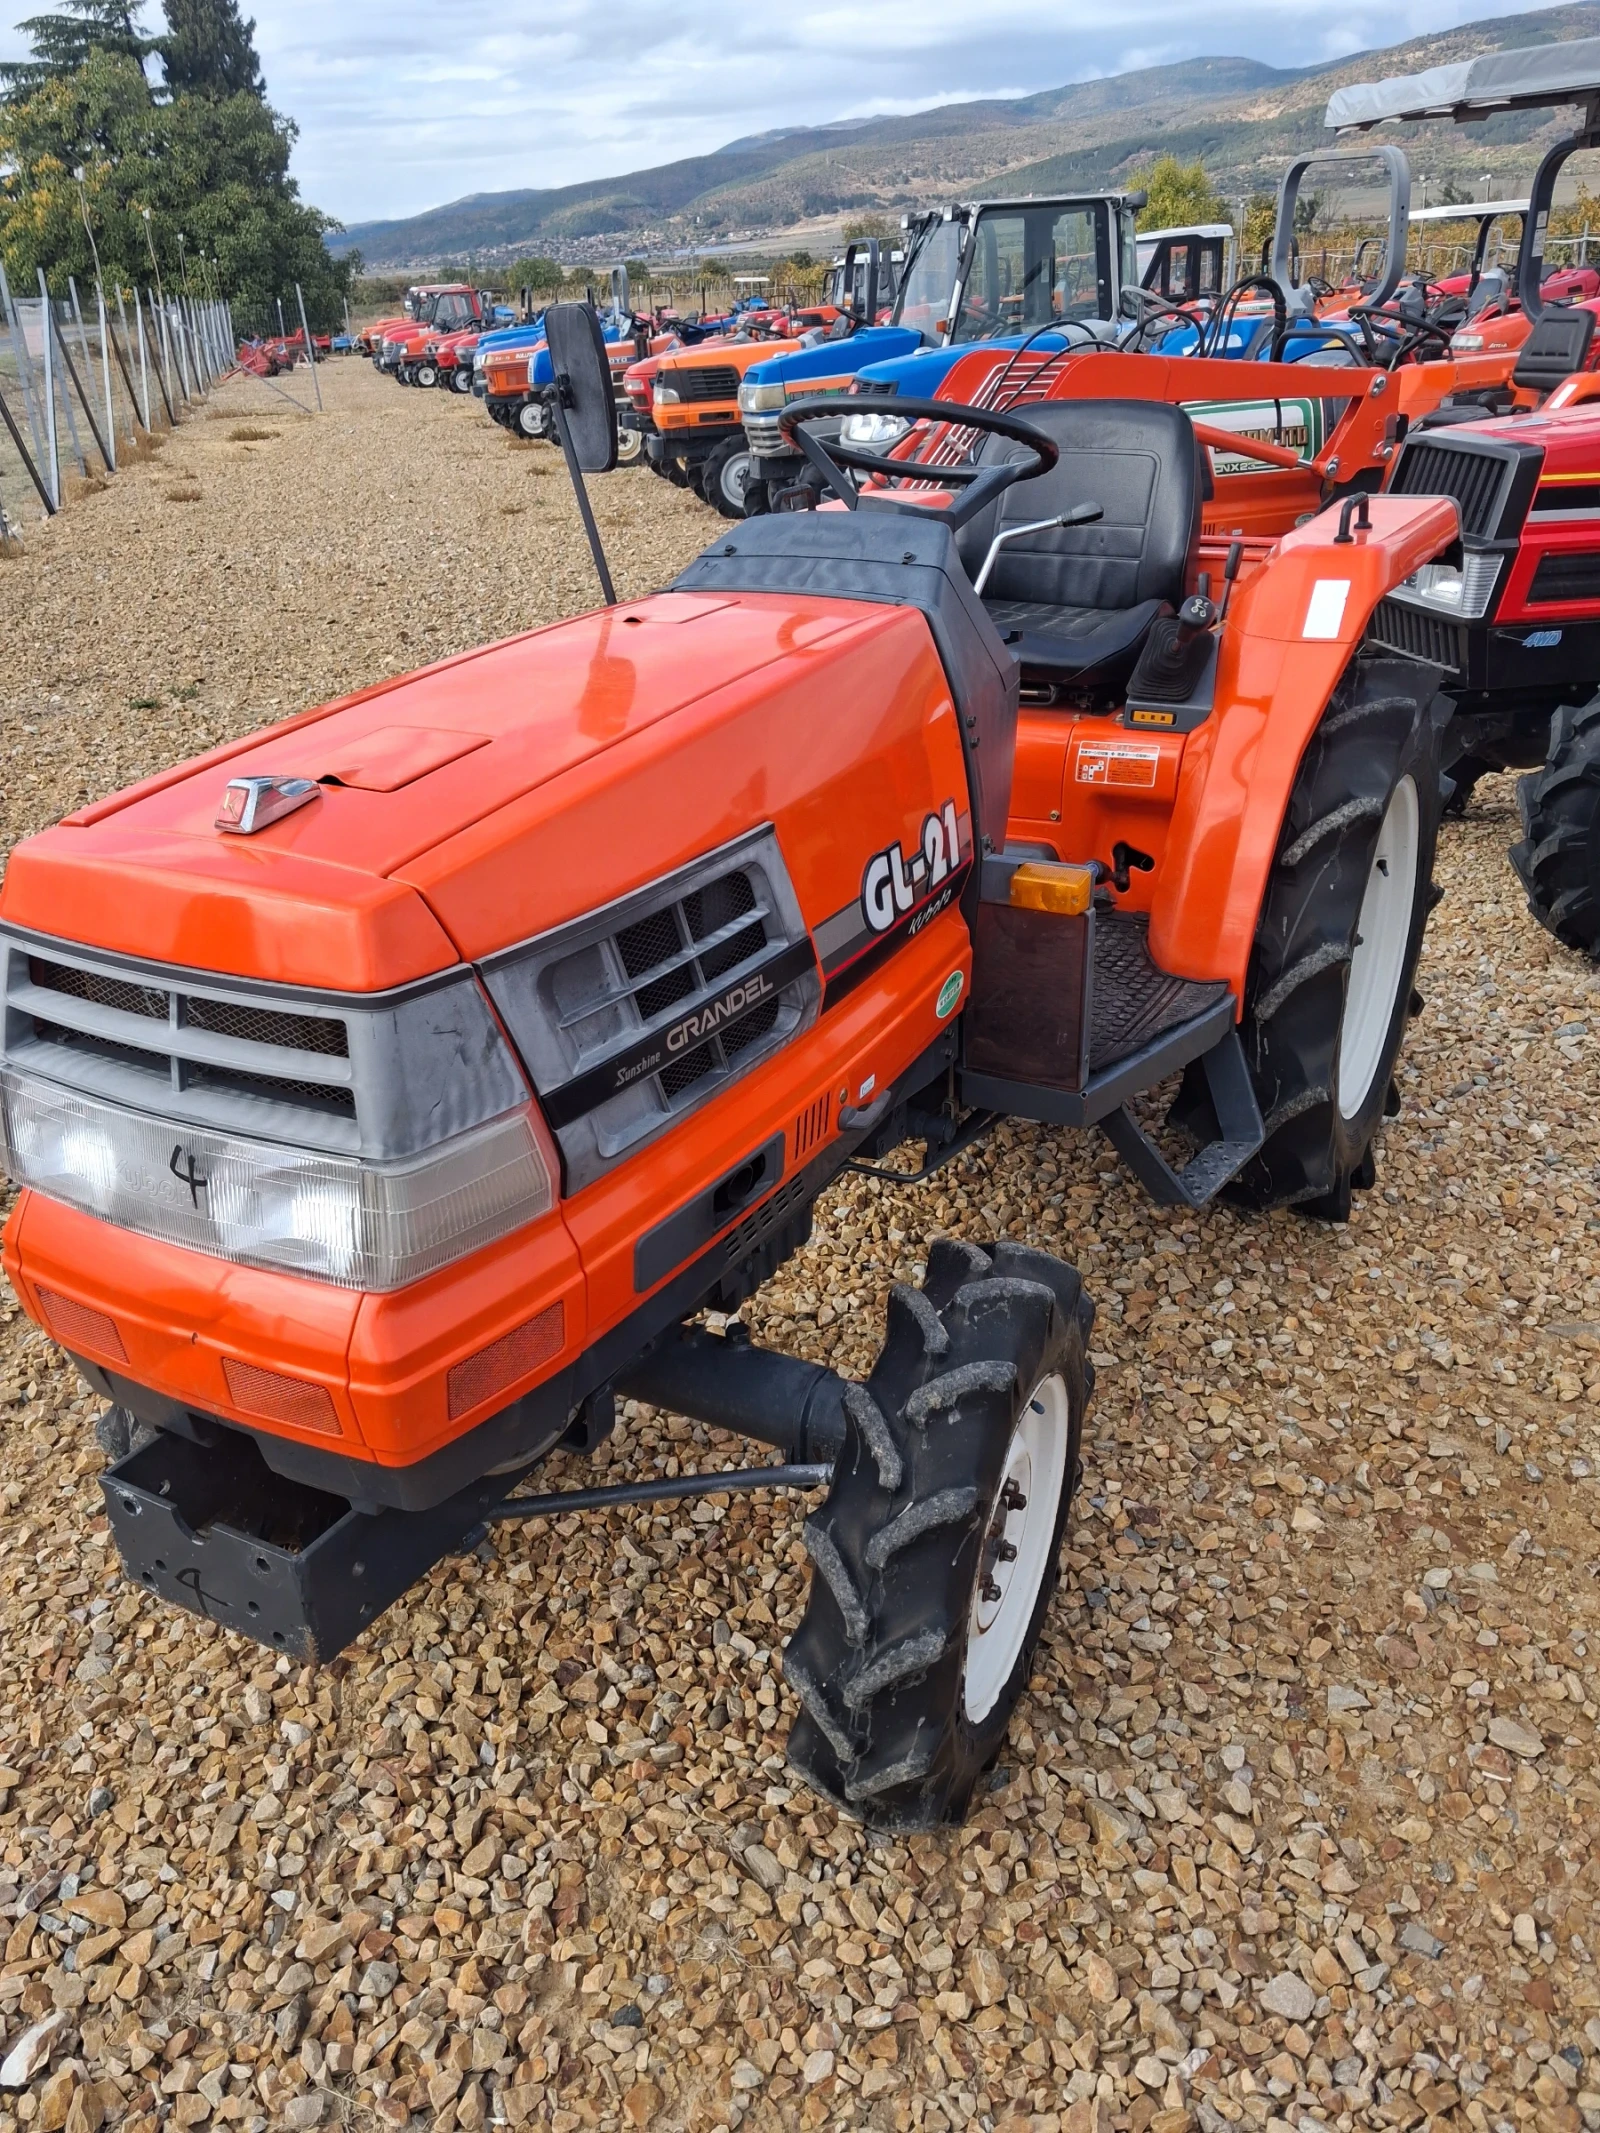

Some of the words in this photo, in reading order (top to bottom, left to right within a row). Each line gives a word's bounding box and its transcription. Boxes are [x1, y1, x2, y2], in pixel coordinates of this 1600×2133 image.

[1353, 331, 1386, 345] ISKI
[1220, 462, 1256, 473] NX23
[1522, 630, 1562, 648] 4WD
[861, 797, 961, 936] GL-21
[613, 1051, 661, 1088] Sunshine
[666, 974, 774, 1052] GRANDEL
[169, 1144, 208, 1210] 4
